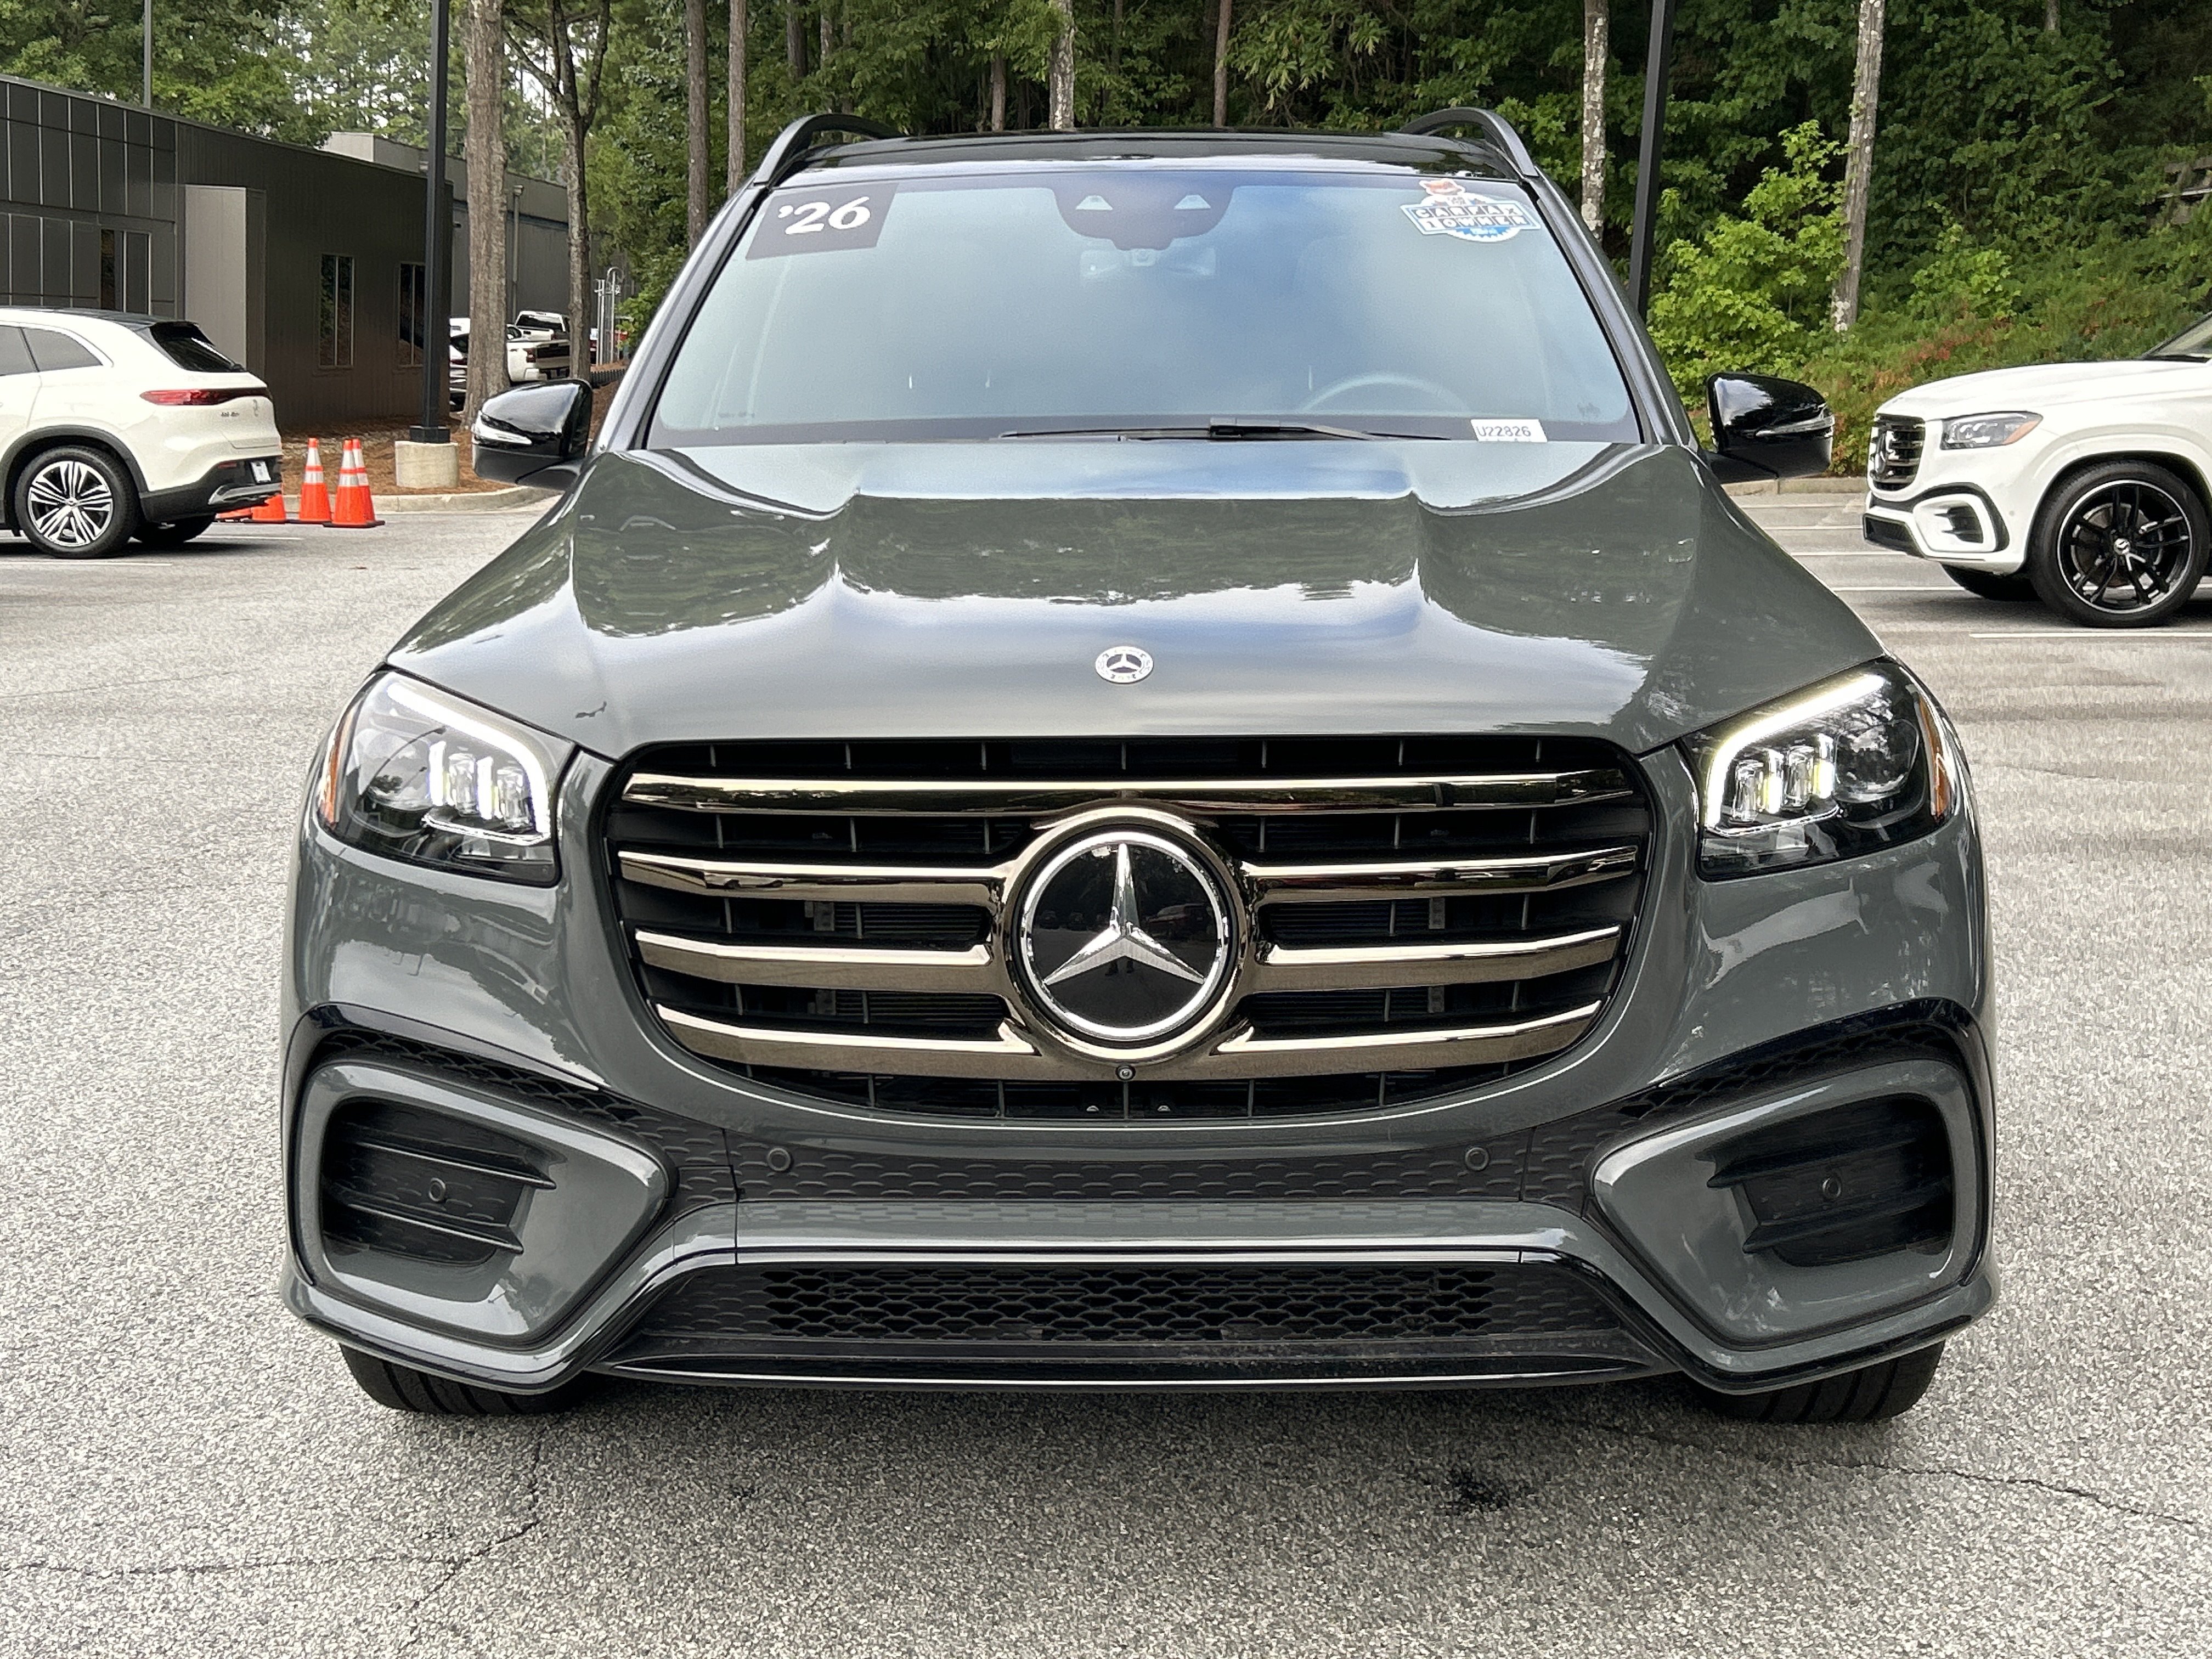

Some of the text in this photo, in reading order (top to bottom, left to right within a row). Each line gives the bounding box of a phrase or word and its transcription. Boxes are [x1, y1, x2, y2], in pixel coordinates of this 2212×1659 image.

[1415, 205, 1522, 218] CARFAX
[1442, 216, 1527, 228] OWNER
[1476, 426, 1531, 437] U22826
